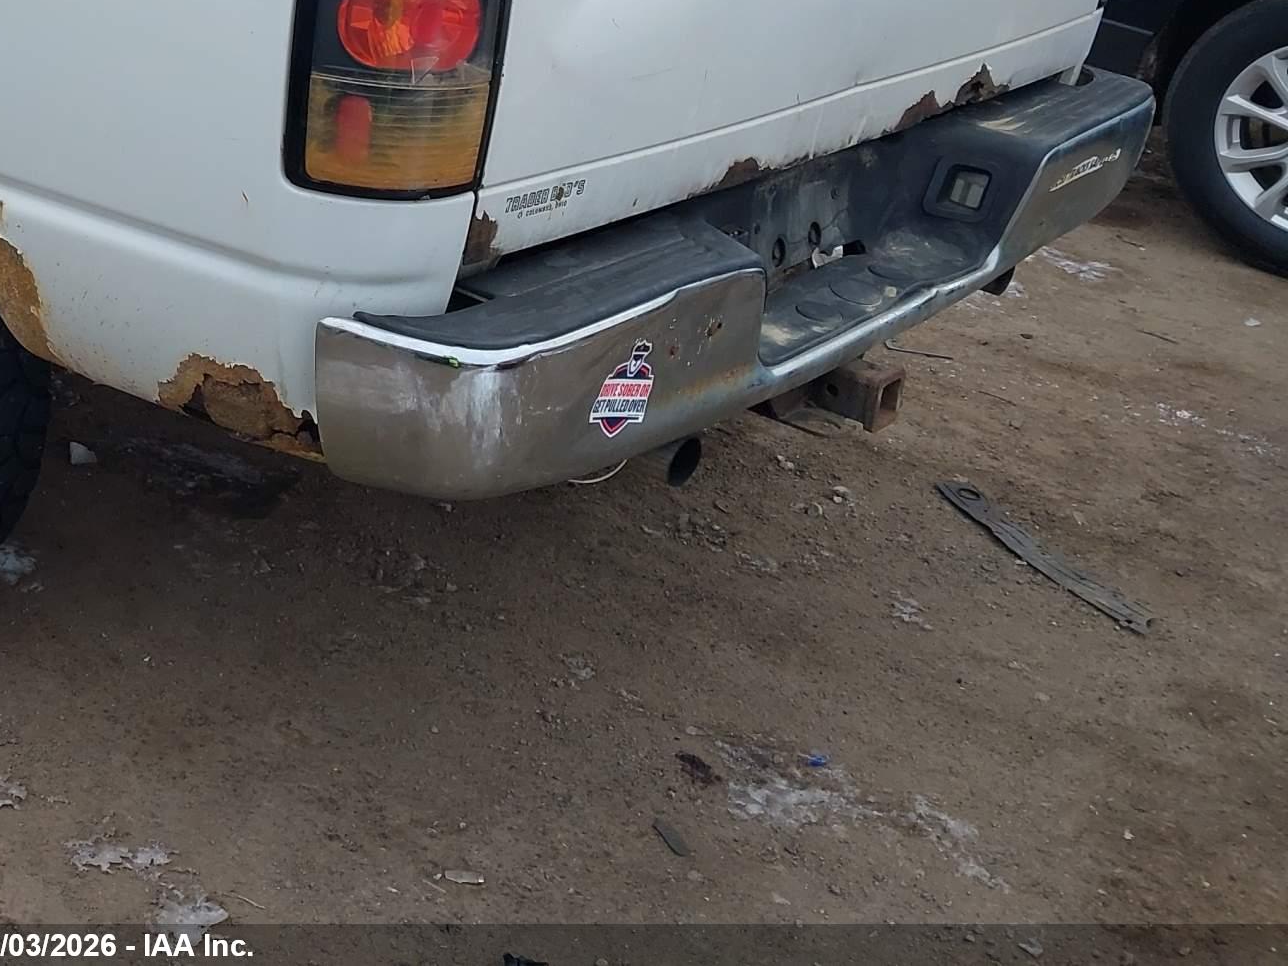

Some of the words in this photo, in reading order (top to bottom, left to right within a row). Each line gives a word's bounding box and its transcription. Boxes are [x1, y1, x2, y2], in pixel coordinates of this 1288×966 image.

[505, 187, 550, 213] TRADER
[600, 383, 620, 398] DRIVE
[618, 383, 642, 398] SOBER
[639, 383, 651, 398] OR
[593, 398, 607, 414] GET
[604, 398, 631, 414] PULLED
[628, 398, 647, 414] OVER
